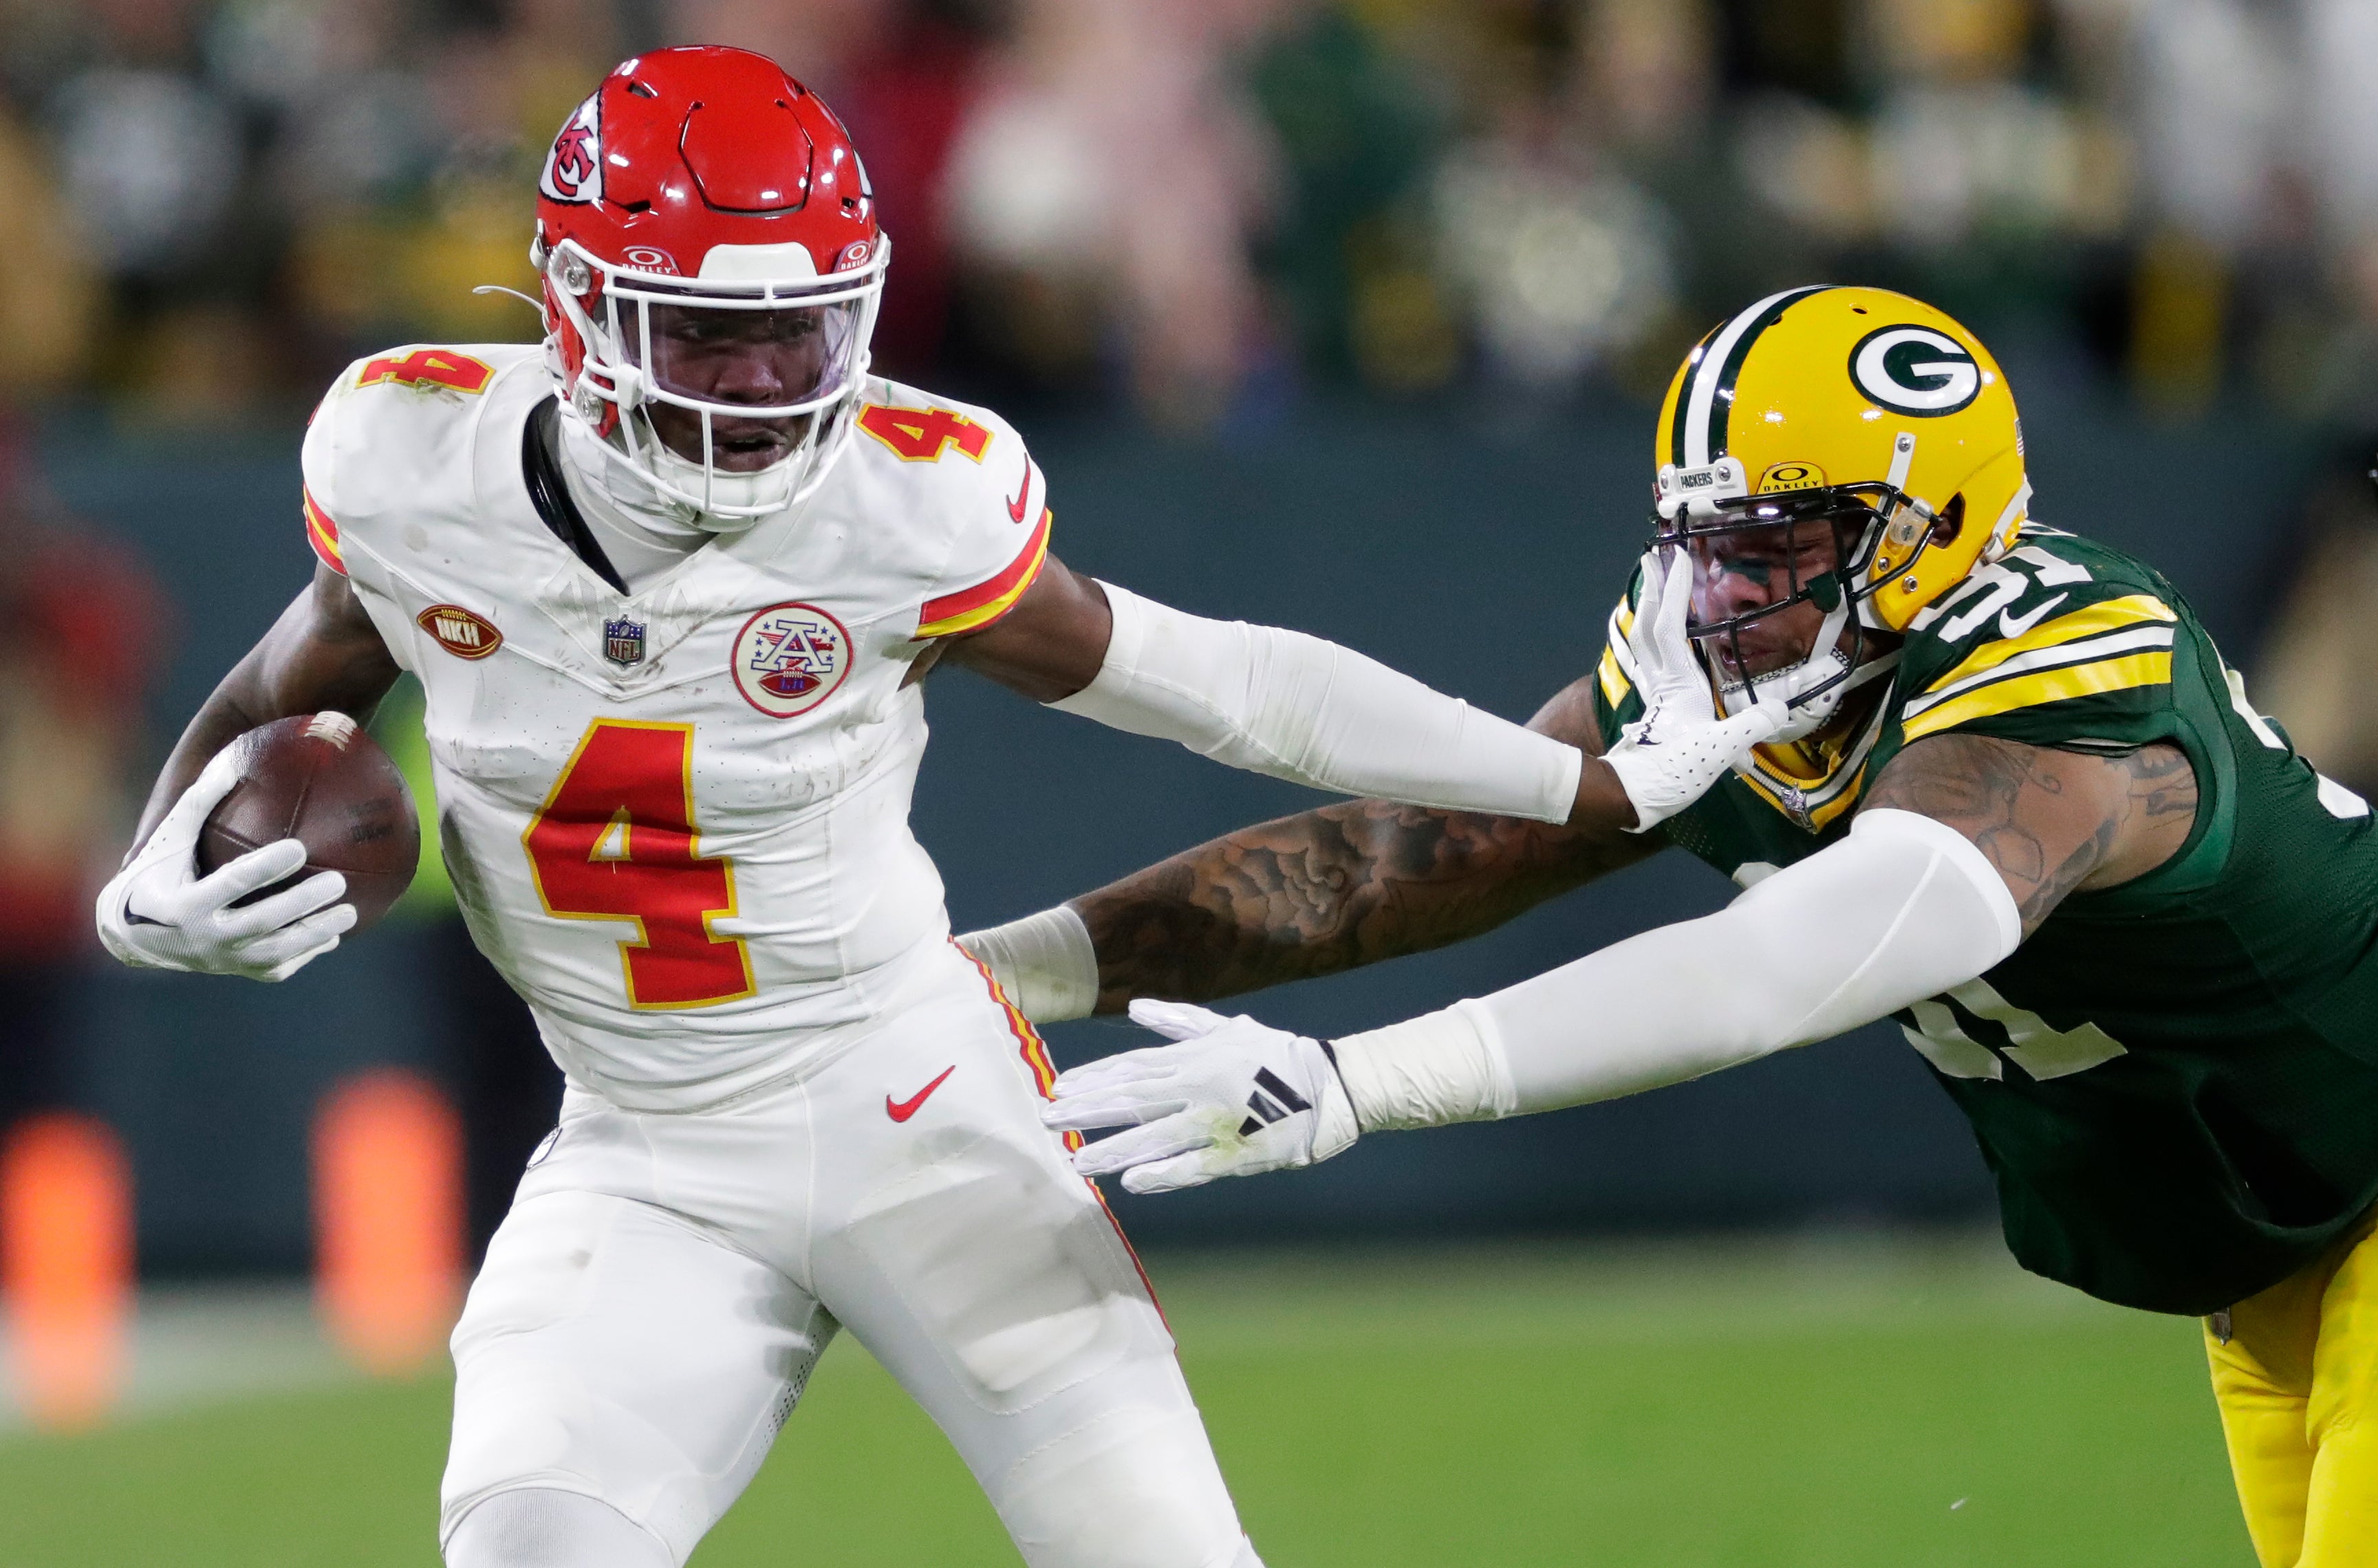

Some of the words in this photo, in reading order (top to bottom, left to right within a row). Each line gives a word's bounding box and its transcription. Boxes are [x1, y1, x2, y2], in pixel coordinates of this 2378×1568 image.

[355, 349, 497, 395] 4
[1857, 329, 1976, 409] G
[855, 403, 995, 465] 4
[1680, 472, 1713, 489] PACKERS
[1764, 480, 1819, 492] OAKLEY
[435, 616, 480, 646] NKH
[609, 640, 640, 660] NFL
[521, 717, 758, 1010] 4
